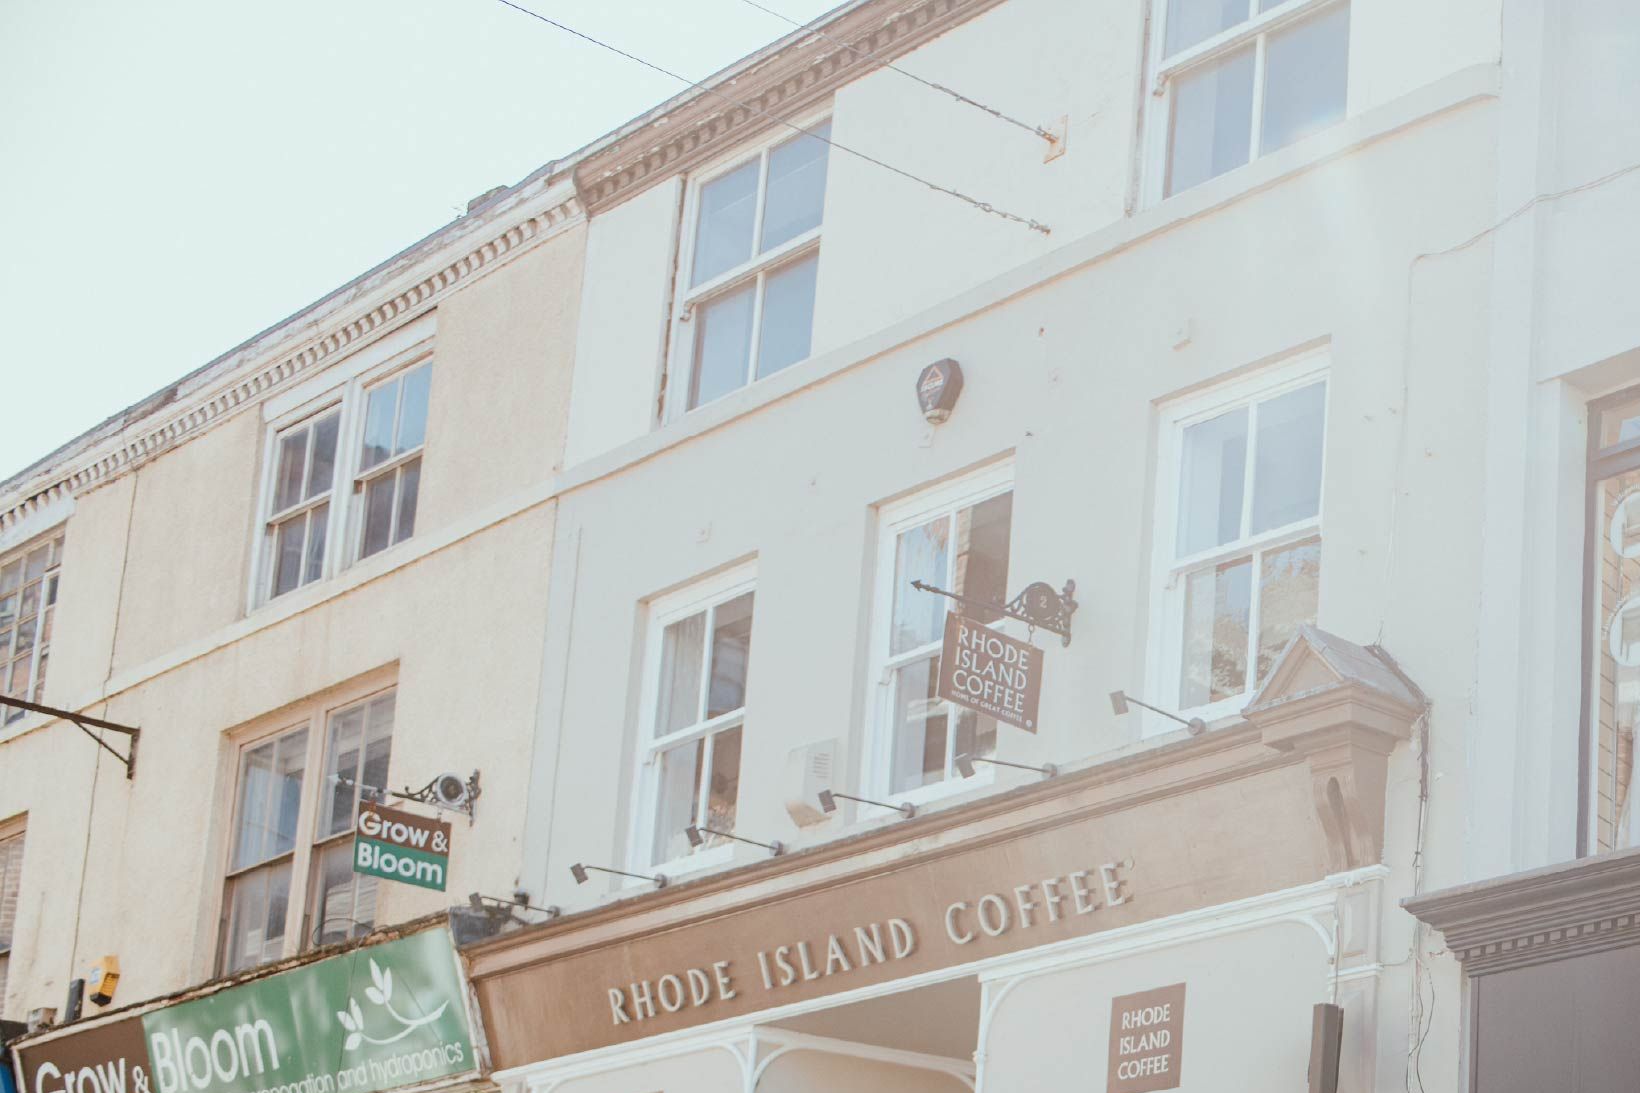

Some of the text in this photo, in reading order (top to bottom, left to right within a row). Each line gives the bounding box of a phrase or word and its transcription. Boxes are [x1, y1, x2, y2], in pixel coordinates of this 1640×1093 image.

[955, 646, 1027, 690] ISLAND
[958, 624, 1030, 671] RHODE
[951, 689, 1023, 723] HOME OF GREAT COFFEE
[953, 669, 1025, 714] COFFEE
[359, 810, 449, 852] Grow &
[357, 842, 443, 885] Bloom
[607, 860, 1130, 1027] RHODE ISLAND COFFEE
[1121, 1003, 1171, 1030] RHODE
[1119, 1029, 1171, 1056] ISLAND
[336, 1066, 368, 1093] and
[368, 1041, 465, 1082] hydroponics
[1117, 1054, 1169, 1080] COFFEE
